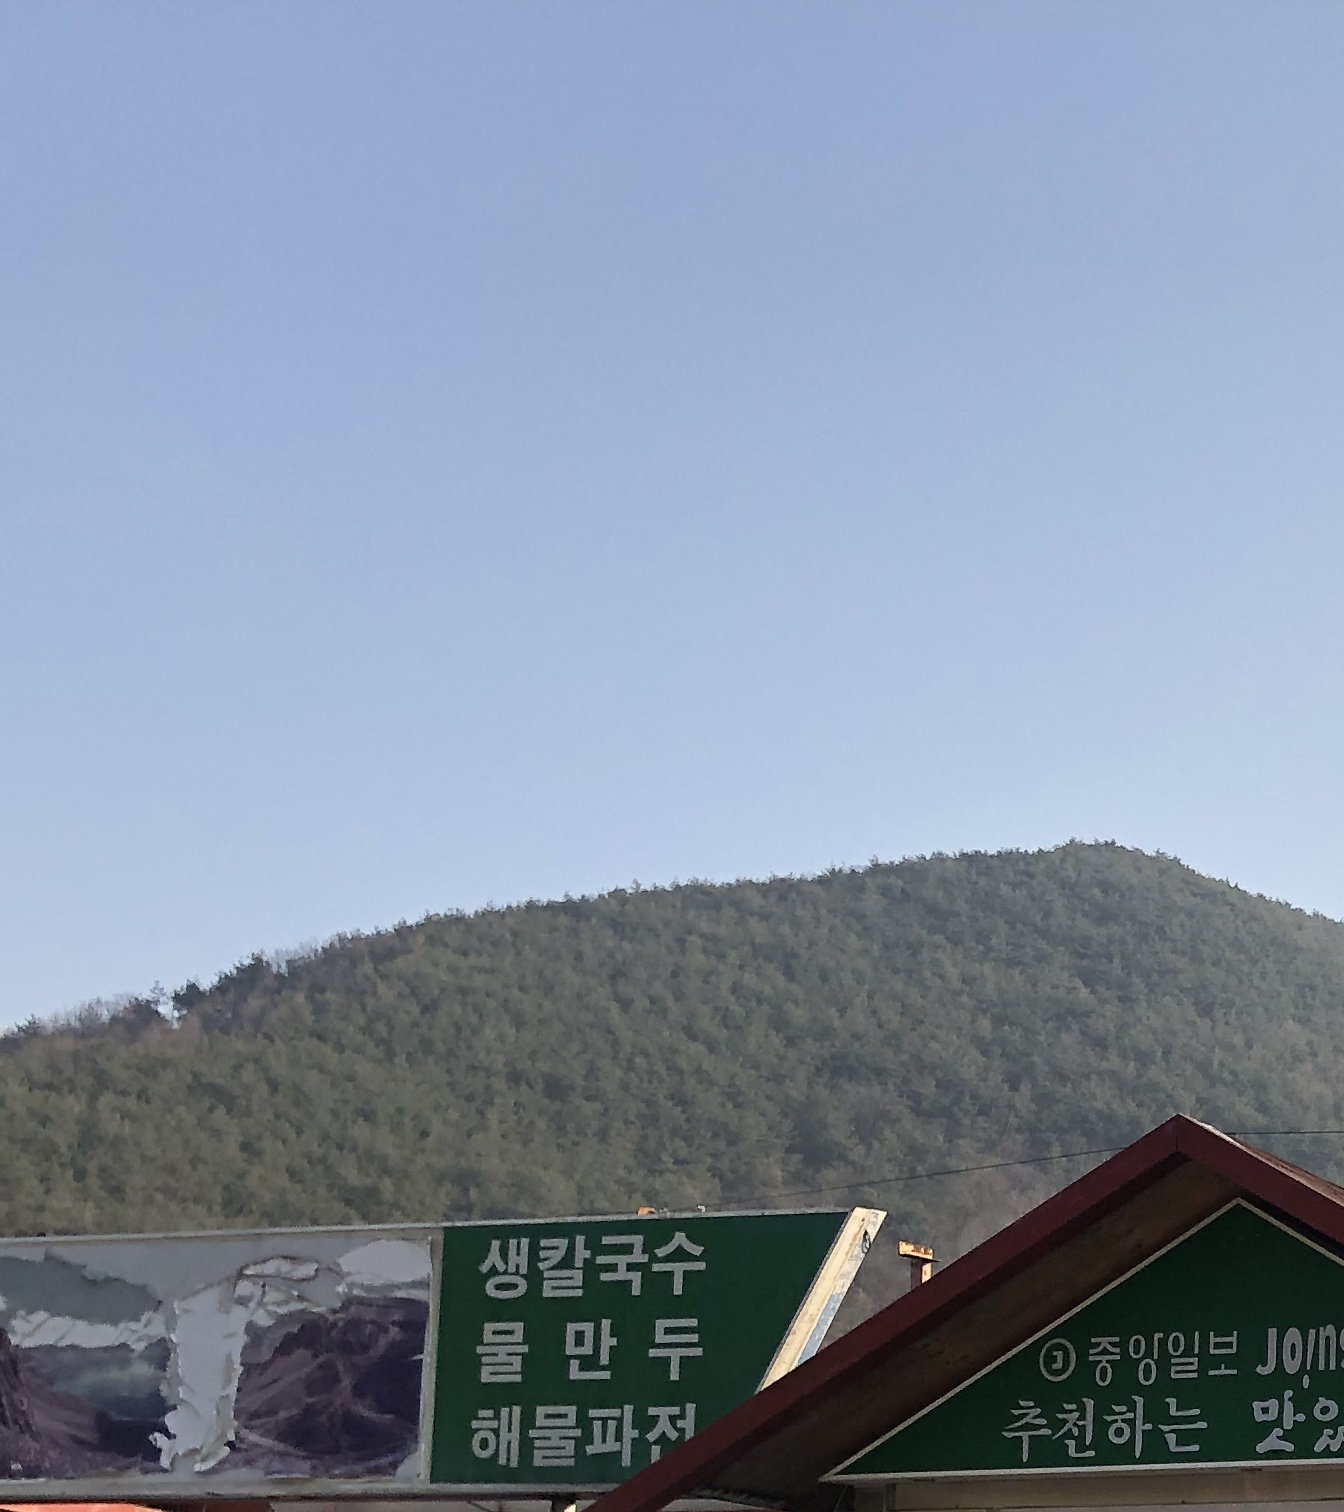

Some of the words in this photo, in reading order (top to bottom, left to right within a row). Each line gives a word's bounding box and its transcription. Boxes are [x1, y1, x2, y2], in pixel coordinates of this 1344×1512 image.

[479, 1232, 706, 1299] 생칼국수
[1089, 1330, 1238, 1387] 중앙일보
[470, 1403, 697, 1468] 해물파전
[1001, 1395, 1208, 1462] 추천하는
